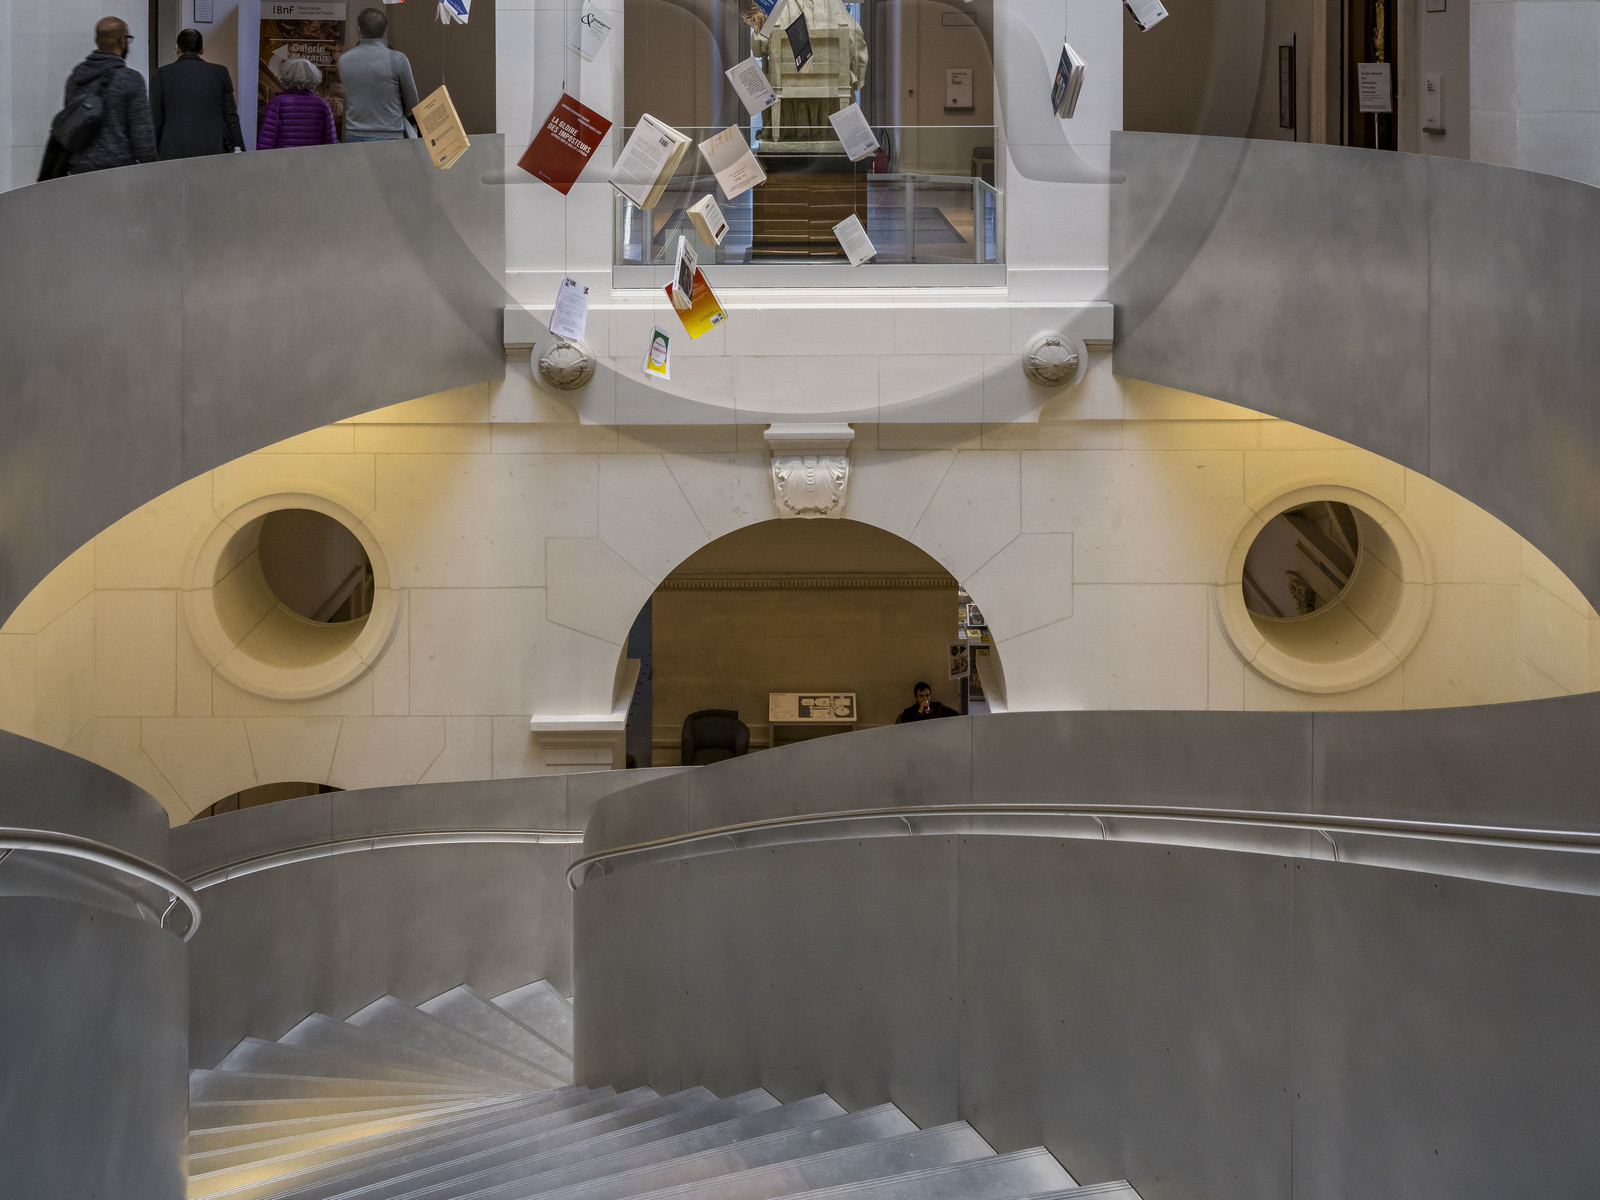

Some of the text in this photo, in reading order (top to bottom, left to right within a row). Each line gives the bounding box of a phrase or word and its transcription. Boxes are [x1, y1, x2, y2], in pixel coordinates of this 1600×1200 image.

[292, 43, 325, 53] Galerie
[551, 116, 578, 137] LA GLOIRE
[547, 123, 592, 154] DES IMPOSTEURS
